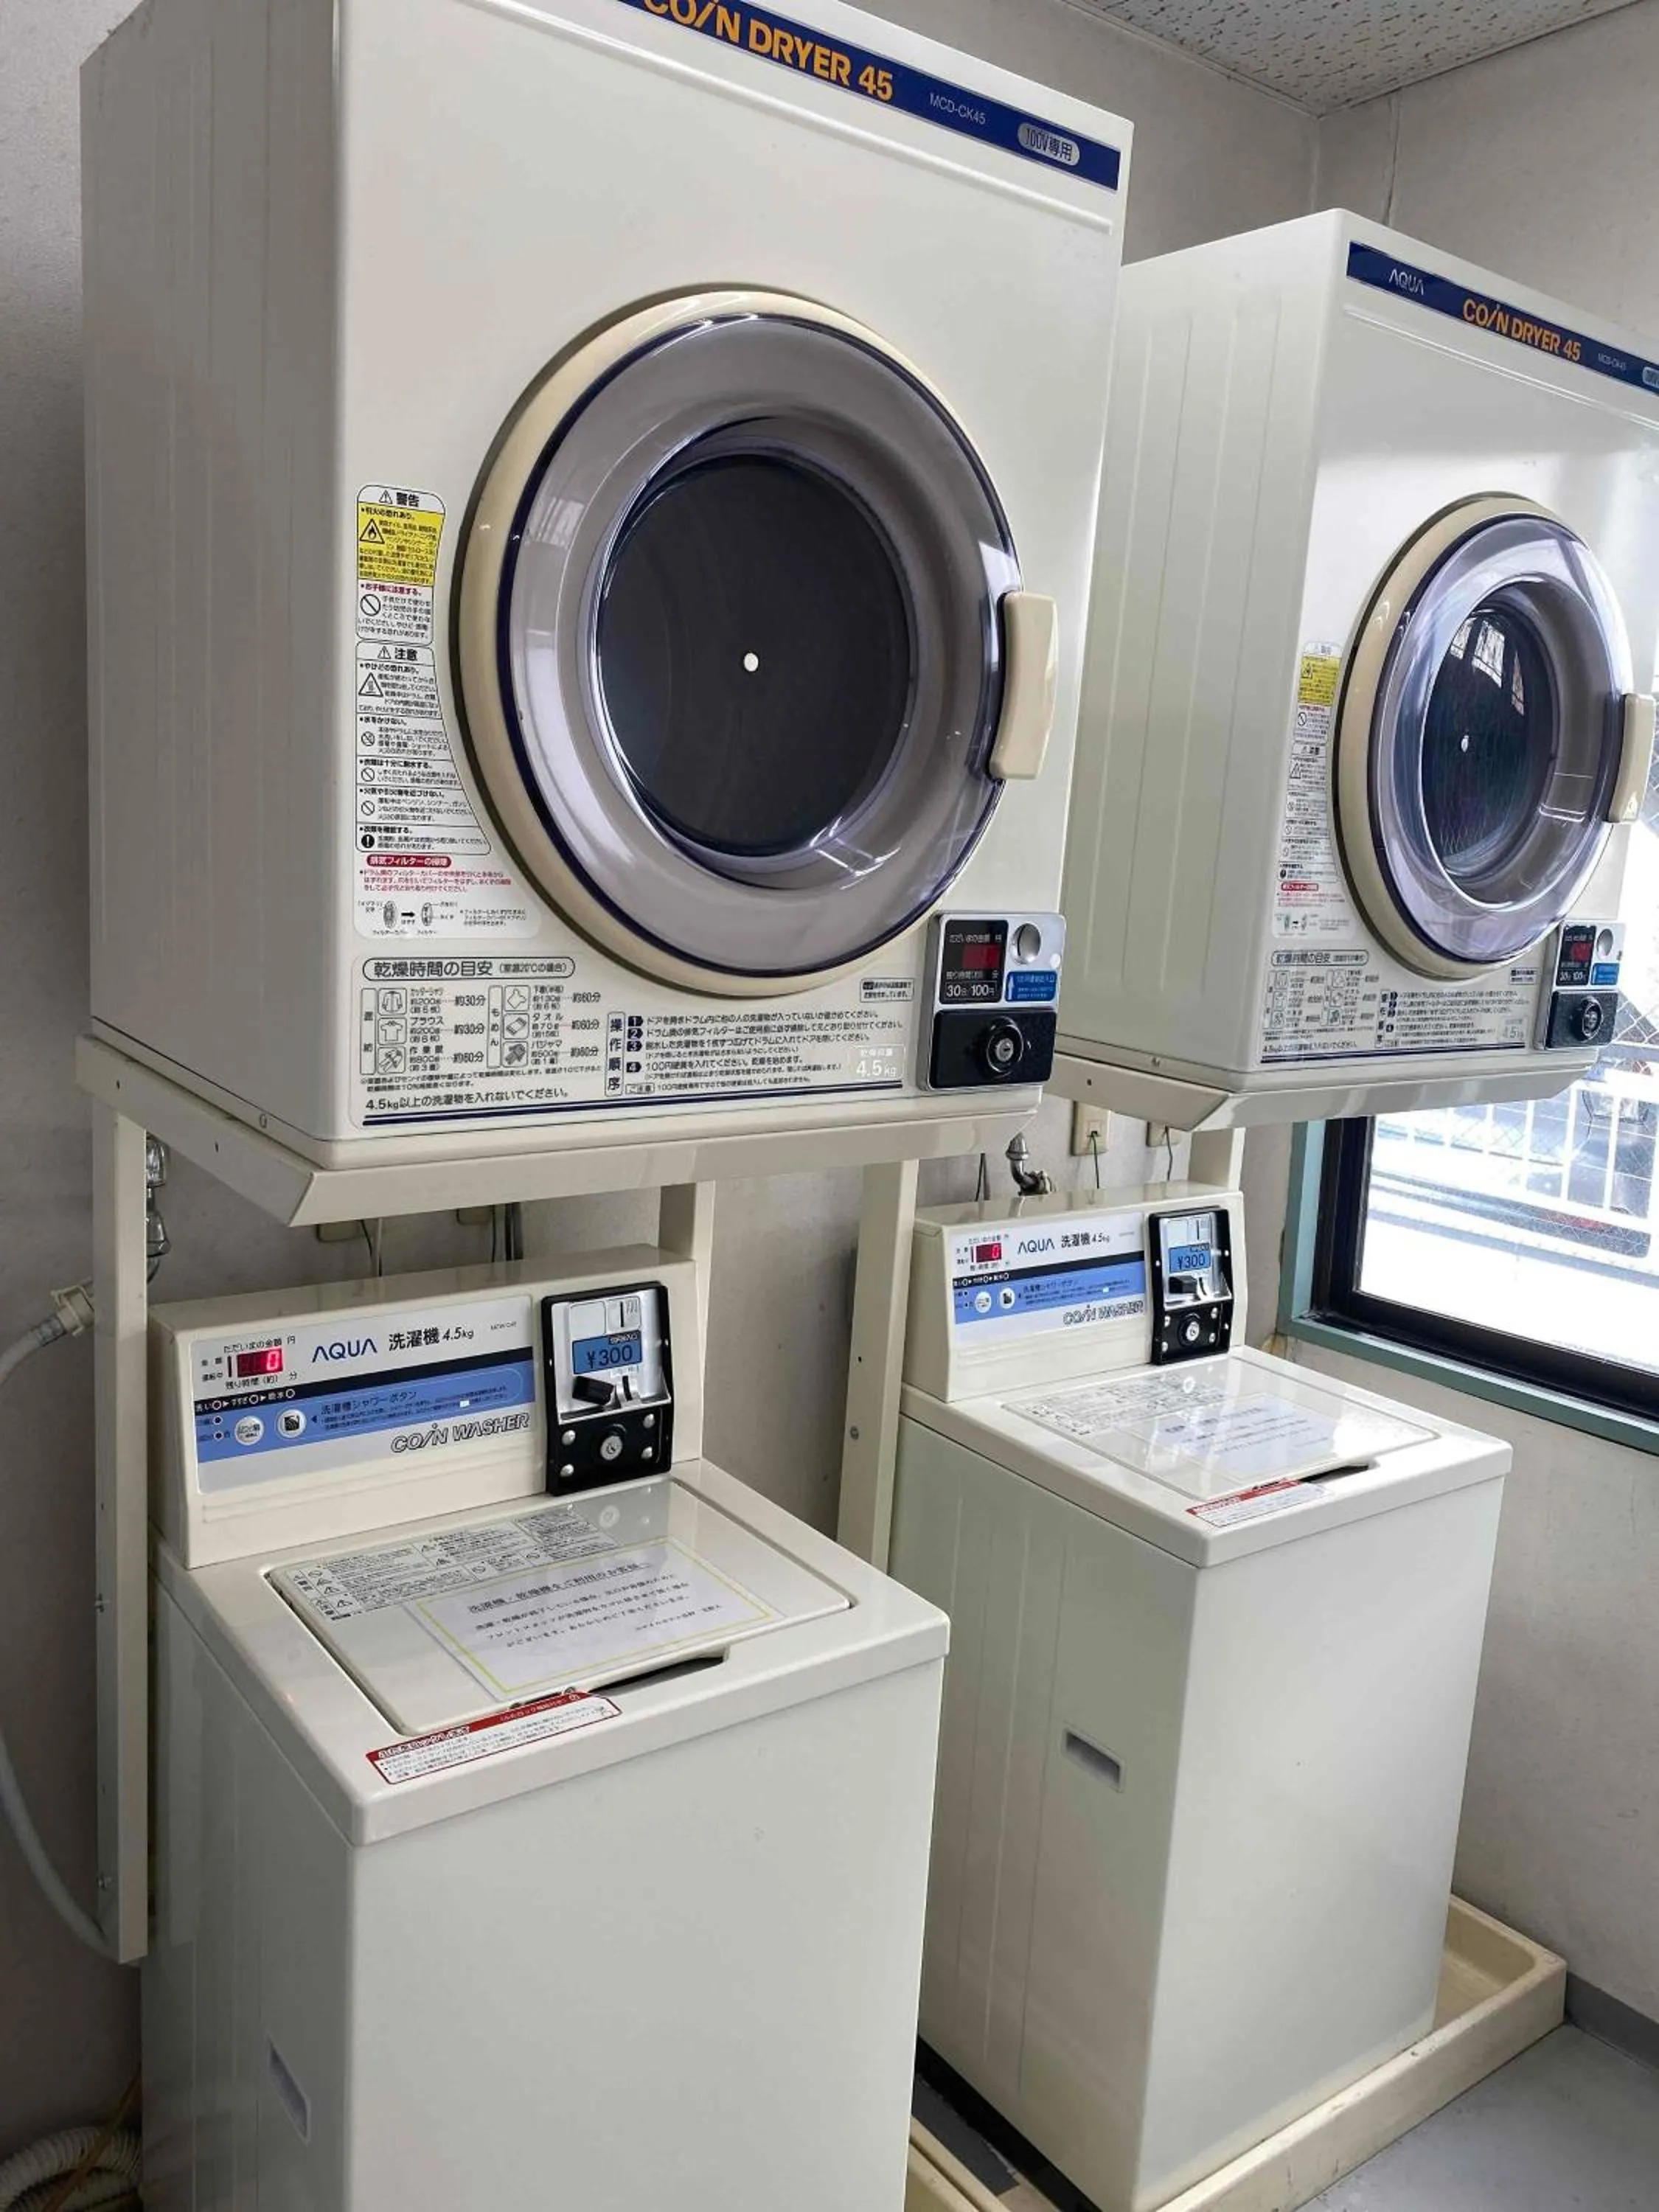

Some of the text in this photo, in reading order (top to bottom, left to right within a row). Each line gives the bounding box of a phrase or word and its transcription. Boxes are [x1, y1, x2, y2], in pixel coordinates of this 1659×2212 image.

[748, 19, 850, 86] DRYER
[858, 65, 893, 101] 45
[929, 92, 987, 125] MCD-CK45
[1388, 268, 1425, 296] AQUA
[1512, 317, 1561, 355] DRYER
[1563, 340, 1581, 361] 45
[396, 493, 419, 507] 警告
[394, 649, 418, 661] 注意
[374, 961, 493, 978] 乾燥時間の目安
[608, 1018, 622, 1091] 操作順序
[992, 1245, 1000, 1259] 0
[1018, 1239, 1055, 1254] AQUA
[1178, 1253, 1205, 1270] ¥300
[1098, 1300, 1144, 1319] WASHER
[224, 1335, 296, 1353] ただいまの金額 円
[389, 1326, 475, 1351] 洗濯機 4.5kg
[313, 1338, 378, 1363] AQUA
[586, 1343, 633, 1369] ¥300
[266, 1351, 280, 1371] 0
[453, 1412, 530, 1441] WASHER
